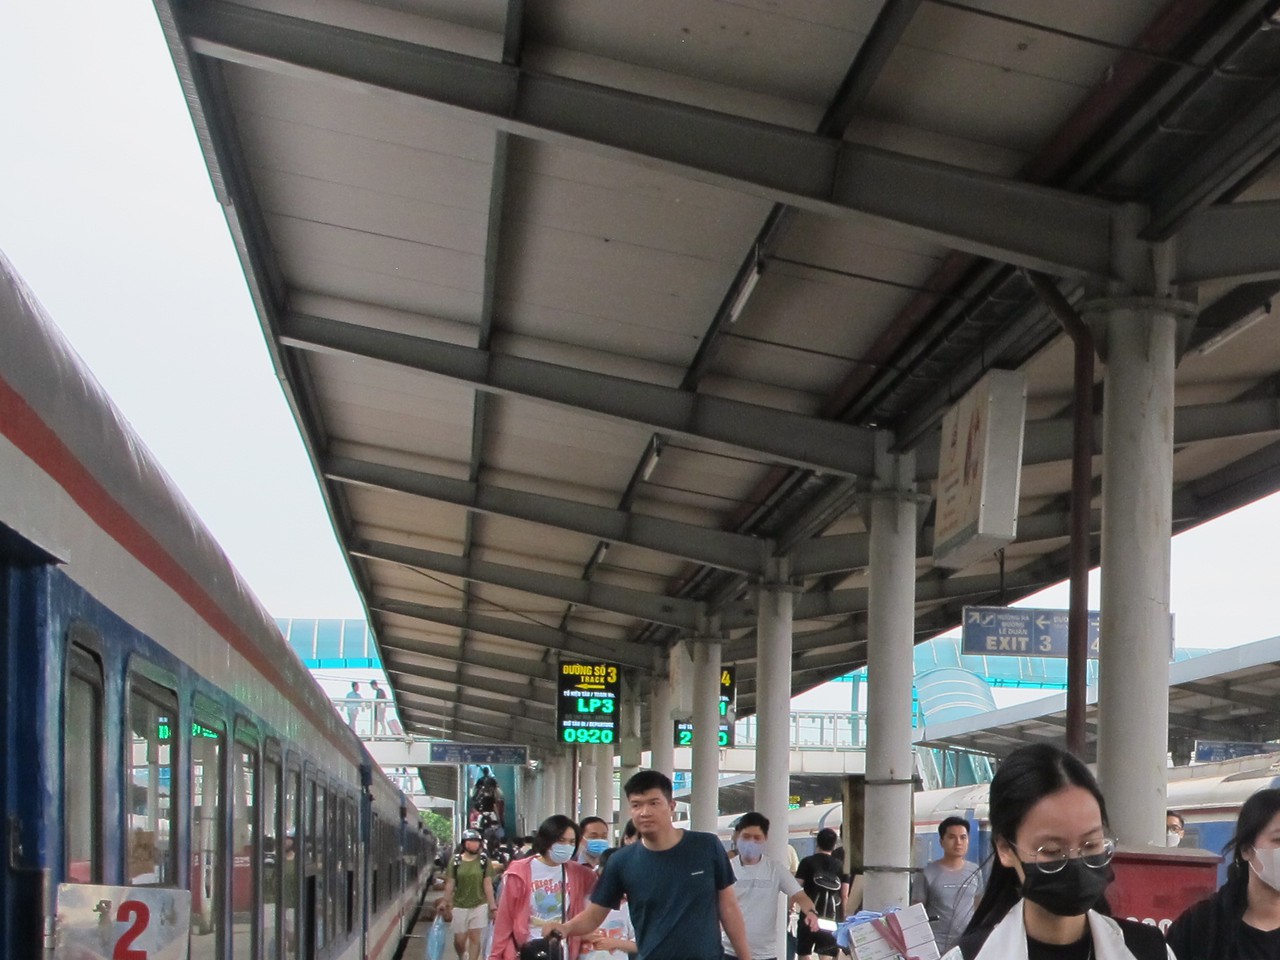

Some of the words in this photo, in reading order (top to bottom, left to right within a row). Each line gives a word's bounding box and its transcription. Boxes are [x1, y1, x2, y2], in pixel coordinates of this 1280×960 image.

[986, 636, 1030, 651] EXIT
[1040, 635, 1052, 651] 3
[607, 667, 617, 683] 3
[721, 670, 731, 686] 4
[577, 698, 614, 713] LP3
[564, 728, 613, 743] 0920
